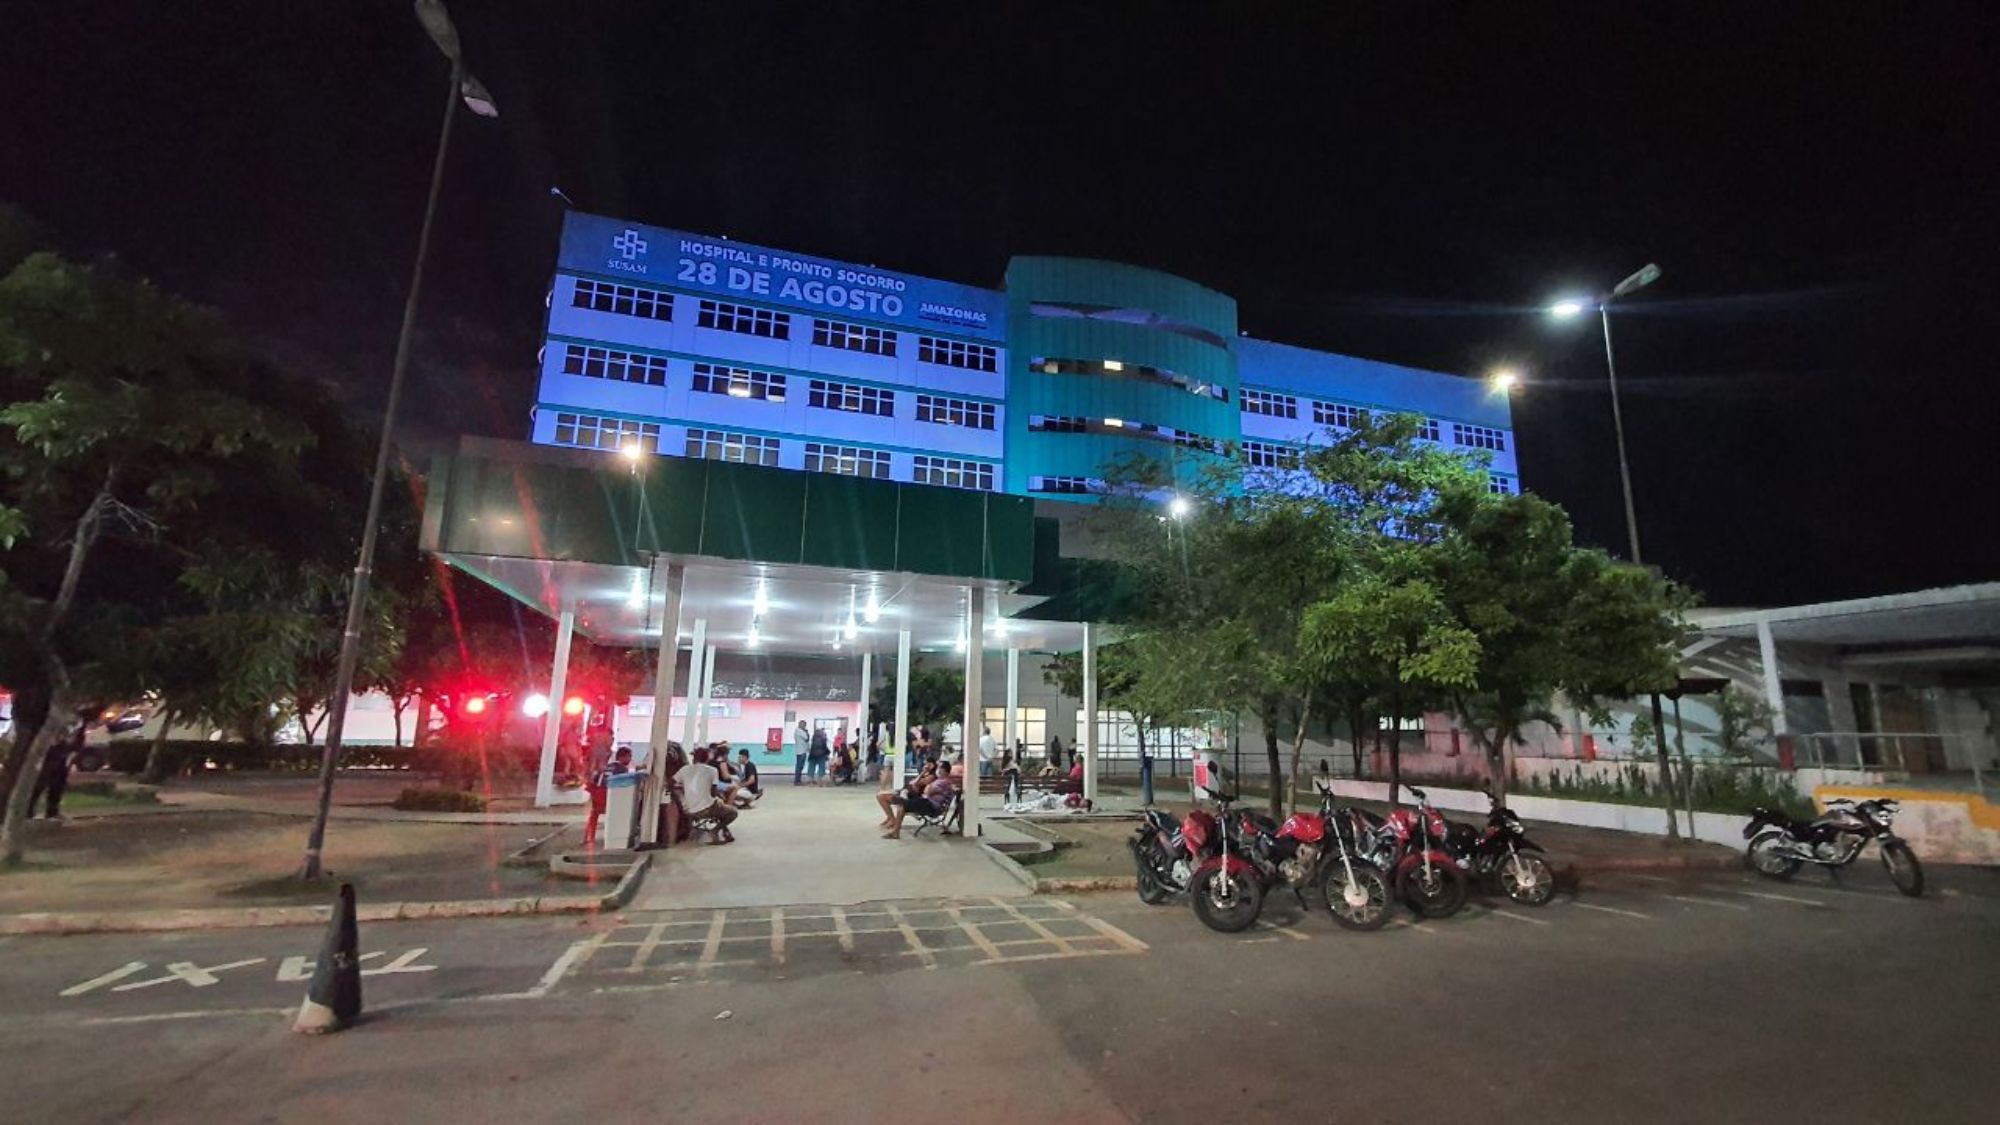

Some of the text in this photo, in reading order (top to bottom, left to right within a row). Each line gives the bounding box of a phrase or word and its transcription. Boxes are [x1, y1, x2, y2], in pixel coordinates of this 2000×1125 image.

[608, 259, 647, 274] SUSAM
[680, 240, 906, 291] HOSPITAL E PRONTO SOCORRO
[677, 258, 903, 317] 28 DE AGOSTO
[920, 302, 987, 321] AMAZONAS
